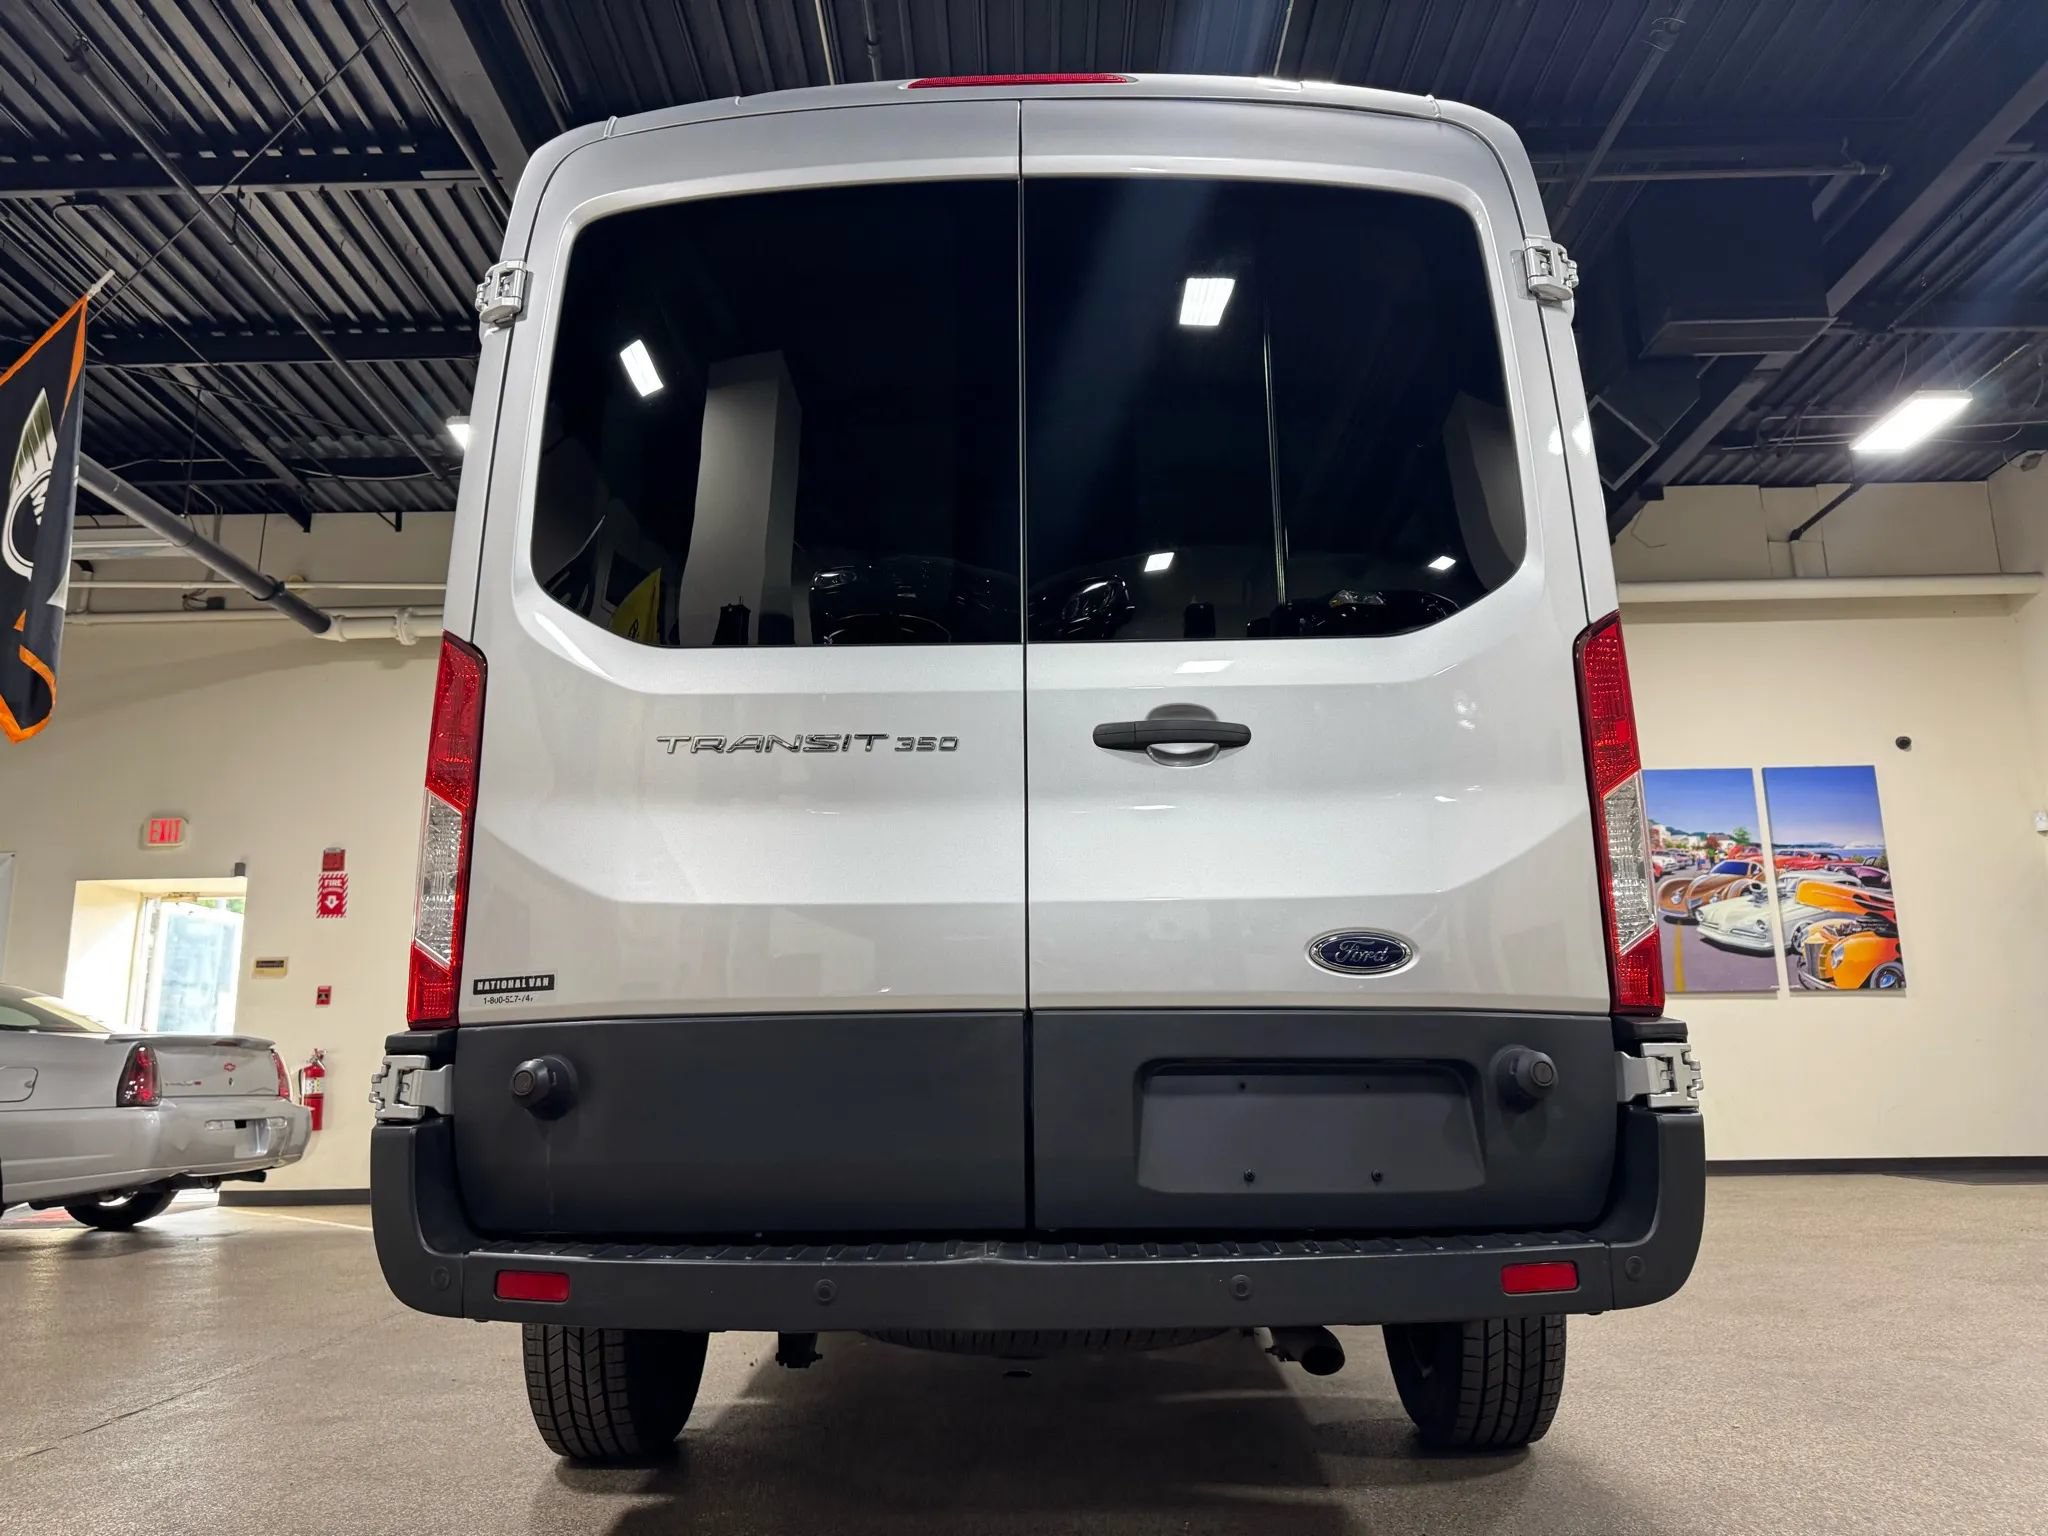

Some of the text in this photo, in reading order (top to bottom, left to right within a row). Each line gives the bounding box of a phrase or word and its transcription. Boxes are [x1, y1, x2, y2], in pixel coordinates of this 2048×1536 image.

[656, 733, 960, 754] TRANSIT 350
[149, 819, 182, 843] EXIT
[324, 879, 342, 887] FIRE
[1335, 940, 1388, 962] Ford
[477, 977, 549, 990] NATIONAL VAN
